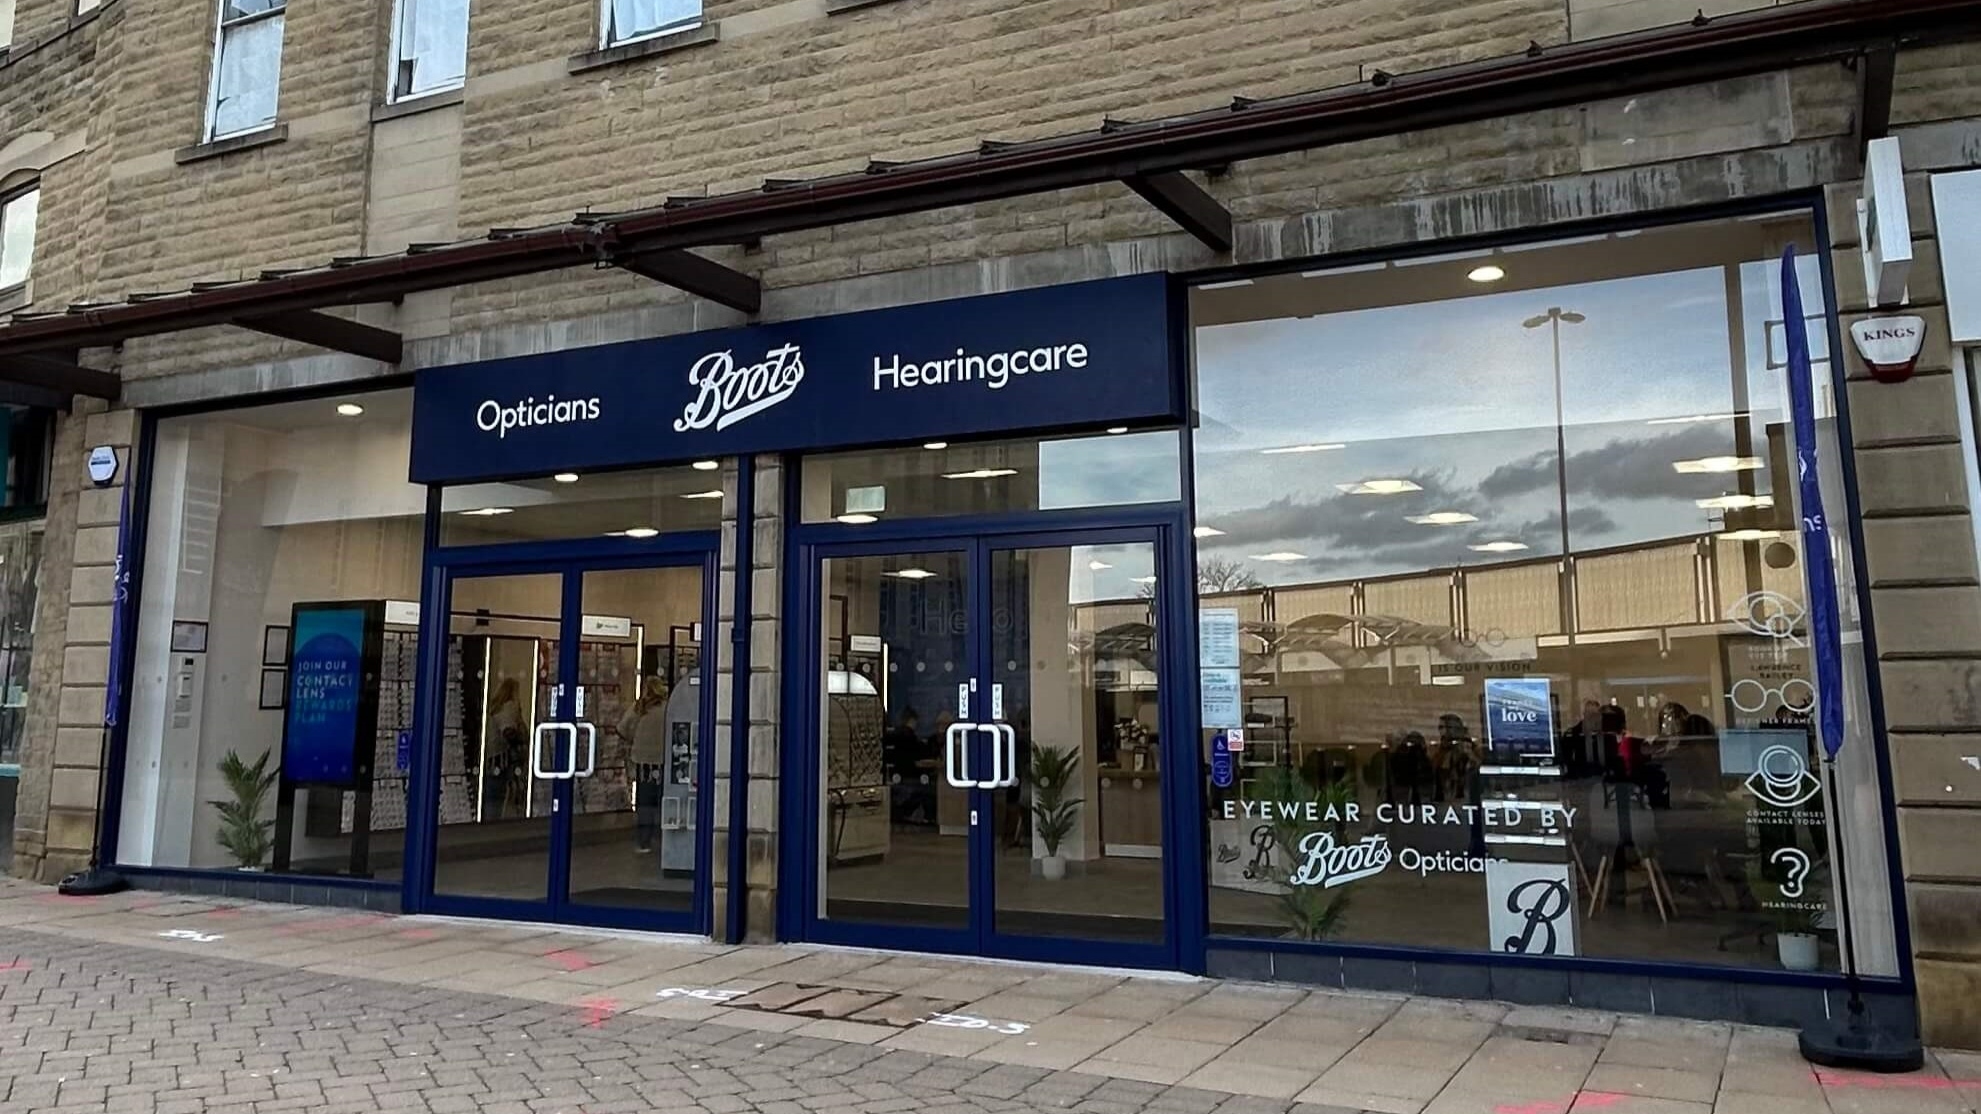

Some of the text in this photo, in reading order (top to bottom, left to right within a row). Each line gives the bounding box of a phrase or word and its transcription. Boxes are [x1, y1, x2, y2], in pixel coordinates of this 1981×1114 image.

[1863, 327, 1915, 341] KINGS
[873, 342, 1088, 391] Hearingcare
[673, 342, 805, 432] Boots
[476, 395, 600, 439] Opticians
[1487, 662, 1531, 672] VISION
[297, 674, 354, 687] CONTACT
[296, 687, 326, 699] LENS
[1502, 708, 1537, 722] love
[1223, 800, 1578, 828] EYEWEAR CURATED BY
[1746, 810, 1825, 819] CONTACT LENSES
[1290, 832, 1393, 889] Boots
[1761, 901, 1827, 910] HEARINGCARE
